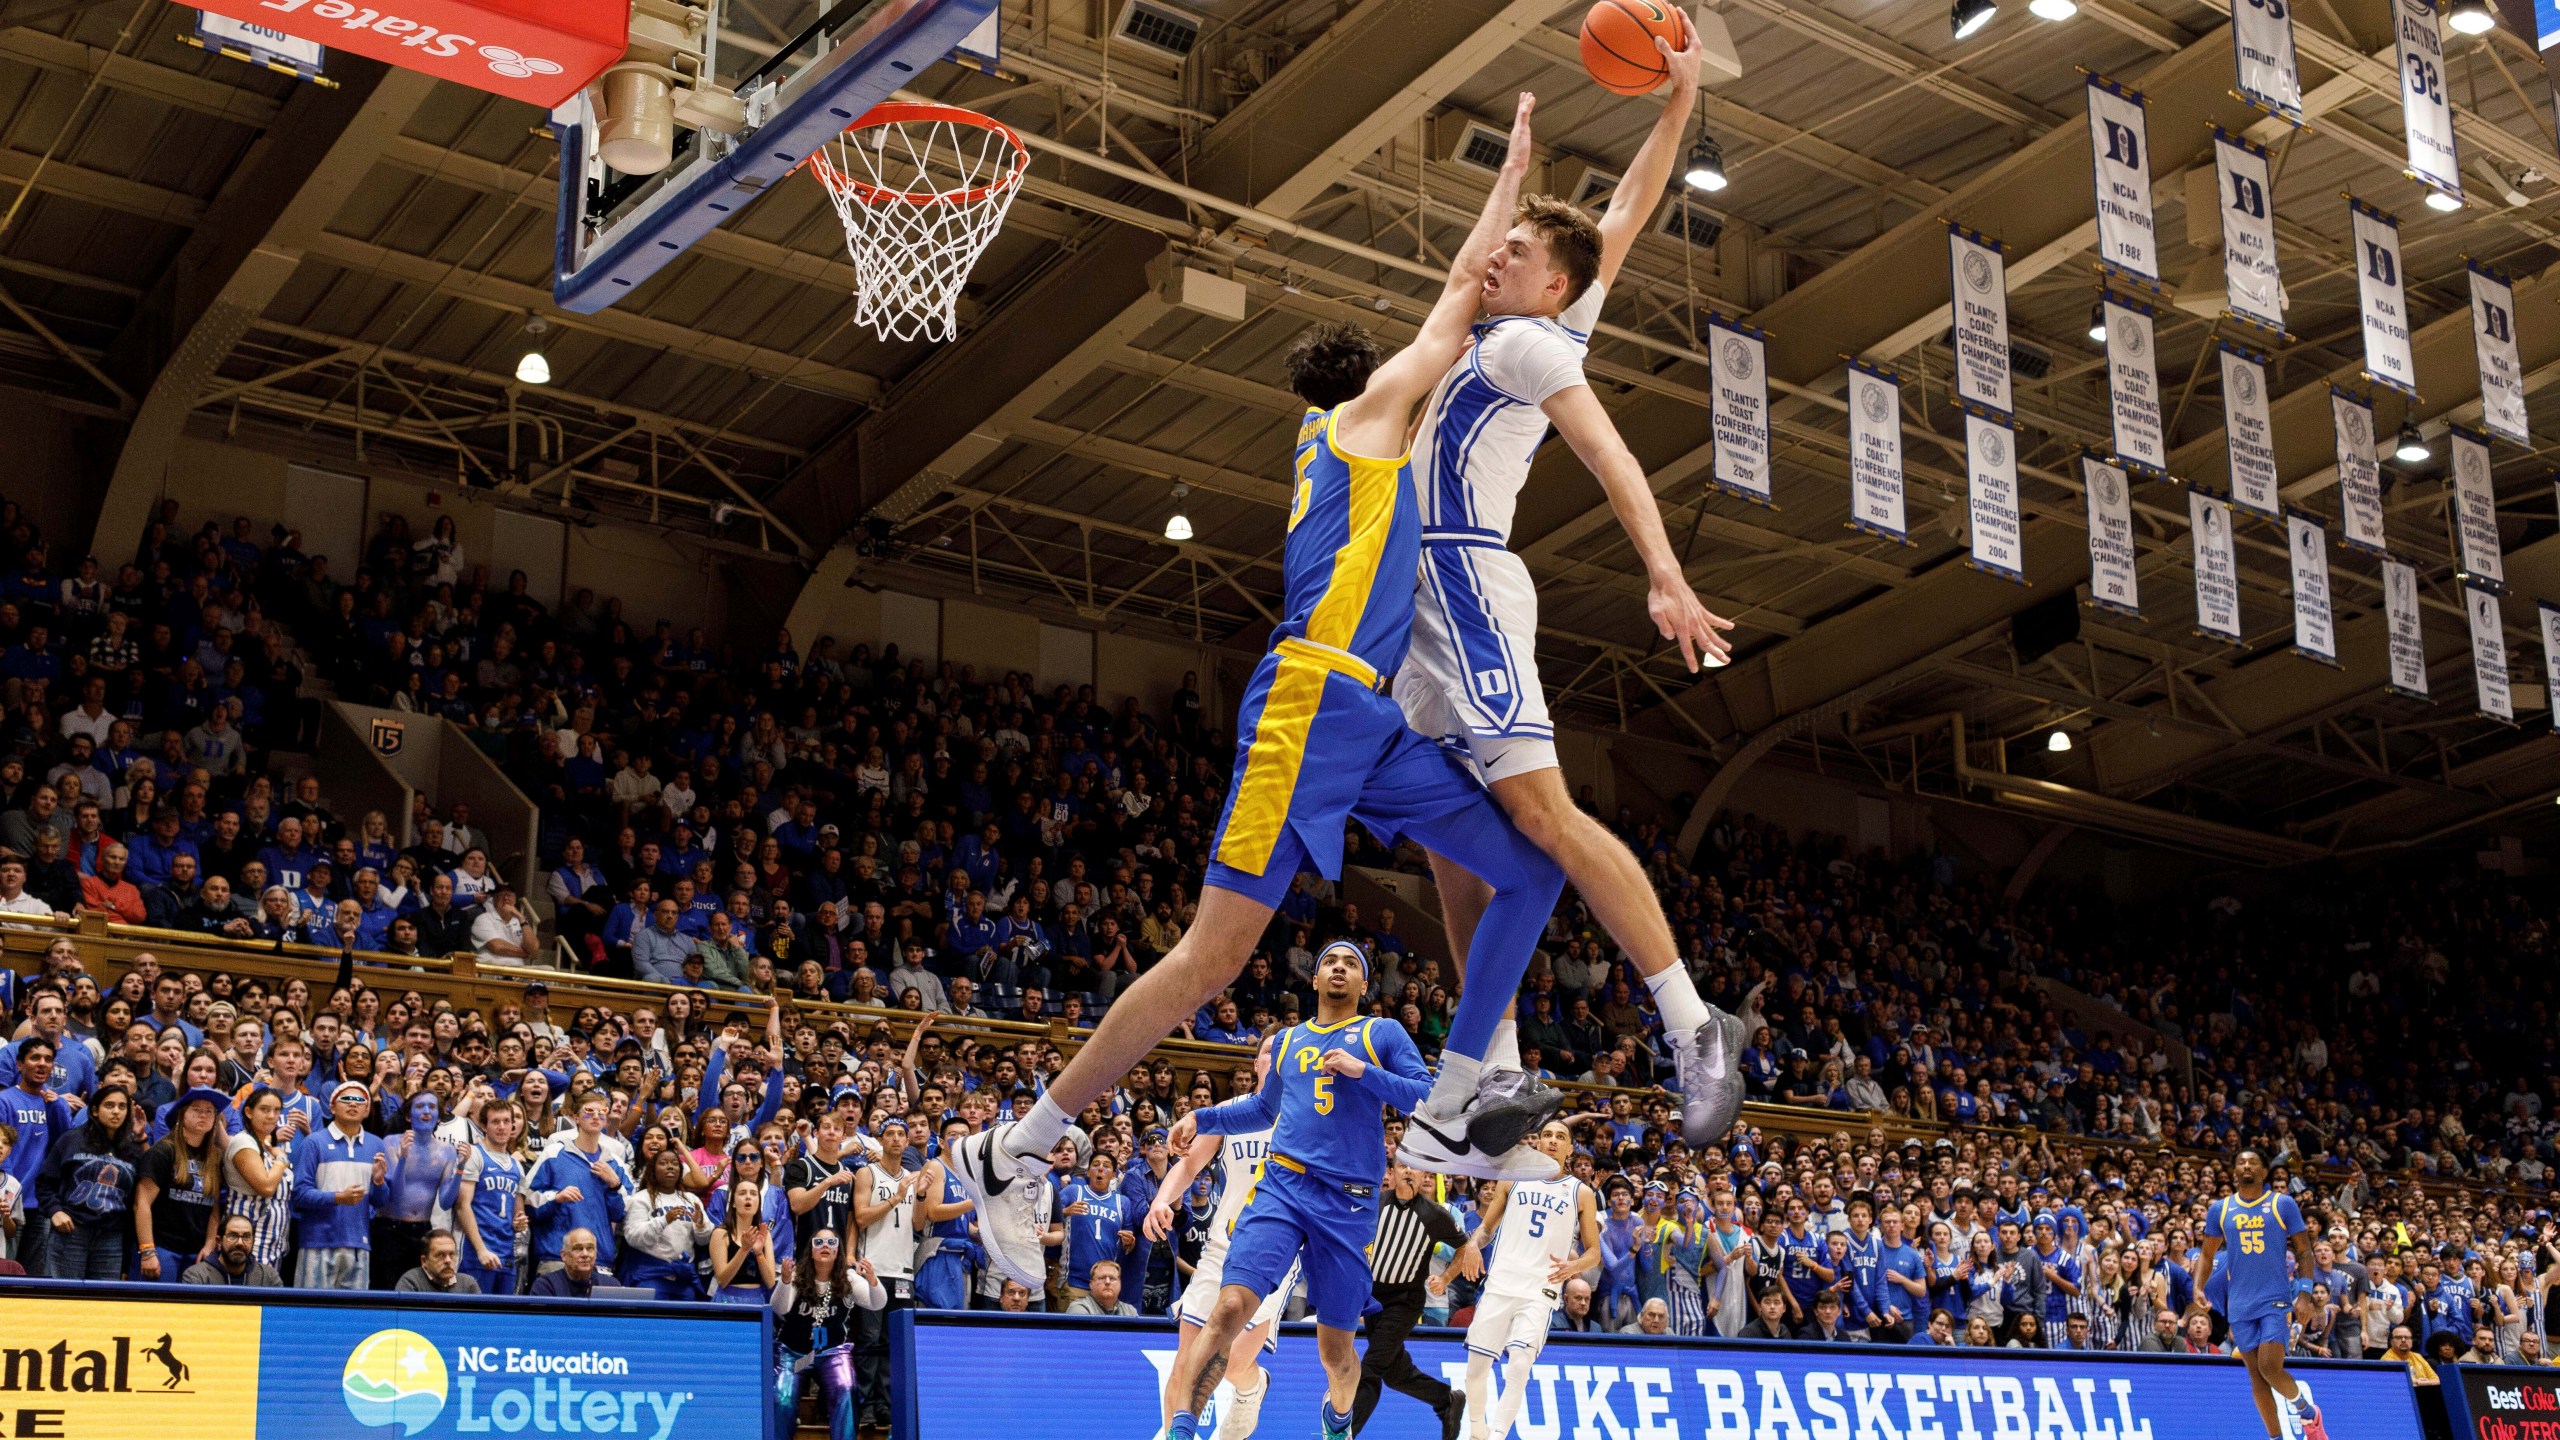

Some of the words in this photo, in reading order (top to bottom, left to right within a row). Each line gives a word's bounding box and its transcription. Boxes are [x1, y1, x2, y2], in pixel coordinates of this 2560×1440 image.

[313, 0, 477, 57] State
[2406, 52, 2442, 106] 32
[2113, 181, 2138, 203] NCAA
[2100, 200, 2128, 222] FINAL
[2118, 241, 2142, 262] 1988
[2239, 231, 2264, 251] NCAA
[1963, 300, 1998, 325] ATLANTIC
[2375, 298, 2396, 317] NCAA
[1969, 316, 1995, 338] COAST
[2366, 315, 2388, 335] FINAL
[1958, 327, 2008, 358] CONFERENCE
[1961, 343, 2008, 372] CHAMPIONS
[2382, 353, 2401, 372] 1990
[2491, 354, 2509, 374] NCAA
[2118, 363, 2150, 386] ATLANTIC
[2482, 371, 2506, 391] FINAL
[1722, 387, 1760, 410] ATLANTIC
[1976, 380, 1998, 400] 1964
[2124, 378, 2147, 397] COAST
[1728, 402, 1754, 422] COAST
[2113, 389, 2160, 416] CONFERENCE
[1714, 413, 1767, 442] CONFERENCE
[2117, 404, 2159, 429] CHAMPIONS
[2234, 411, 2265, 432] ATLANTIC
[1717, 429, 1764, 456] CHAMPIONS
[1859, 431, 1894, 453] ATLANTIC
[2239, 425, 2260, 443] COAST
[1865, 446, 1890, 465] COAST
[2230, 436, 2274, 462] CONFERENCE
[1854, 457, 1902, 483] CONFERENCE
[2233, 450, 2273, 475] CHAMPIONS
[1856, 472, 1901, 496] CHAMPIONS
[1977, 472, 2011, 494] ATLANTIC
[2351, 467, 2374, 482] COAST
[1287, 443, 1318, 533] 5
[1983, 487, 2007, 506] COAST
[1870, 504, 1889, 520] 2003
[1972, 498, 2019, 523] CONFERENCE
[1975, 511, 2018, 536] CHAMPIONS
[1988, 544, 2008, 561] 2004
[2206, 558, 2228, 574] COAST
[2196, 568, 2235, 591] CONFERENCE
[2198, 581, 2235, 603] CHAMPIONS
[376, 728, 400, 749] 15
[1054, 809, 1069, 823] GO
[1314, 1076, 1334, 1116] 5
[17, 1109, 47, 1124] DUK
[1232, 1140, 1271, 1161] DUK
[499, 1193, 507, 1218] 1
[1516, 1190, 1570, 1217] DUKE
[827, 1205, 834, 1229] 1
[894, 1207, 900, 1228] 1
[1528, 1209, 1548, 1239] 5
[2232, 1213, 2266, 1230] Pitt
[1094, 1219, 1102, 1240] 1
[2239, 1230, 2266, 1255] 55
[1854, 1256, 1877, 1268] DUKE
[1861, 1267, 1869, 1286] 1
[2443, 1285, 2472, 1299] DUKE
[458, 1347, 499, 1373] NC
[505, 1347, 628, 1375] Education
[457, 1374, 686, 1438] Lottery
[1696, 1368, 2152, 1440] BASKETBALL
[2487, 1385, 2525, 1411] Best
[2522, 1385, 2557, 1411] Coke
[2479, 1415, 2518, 1440] Coke
